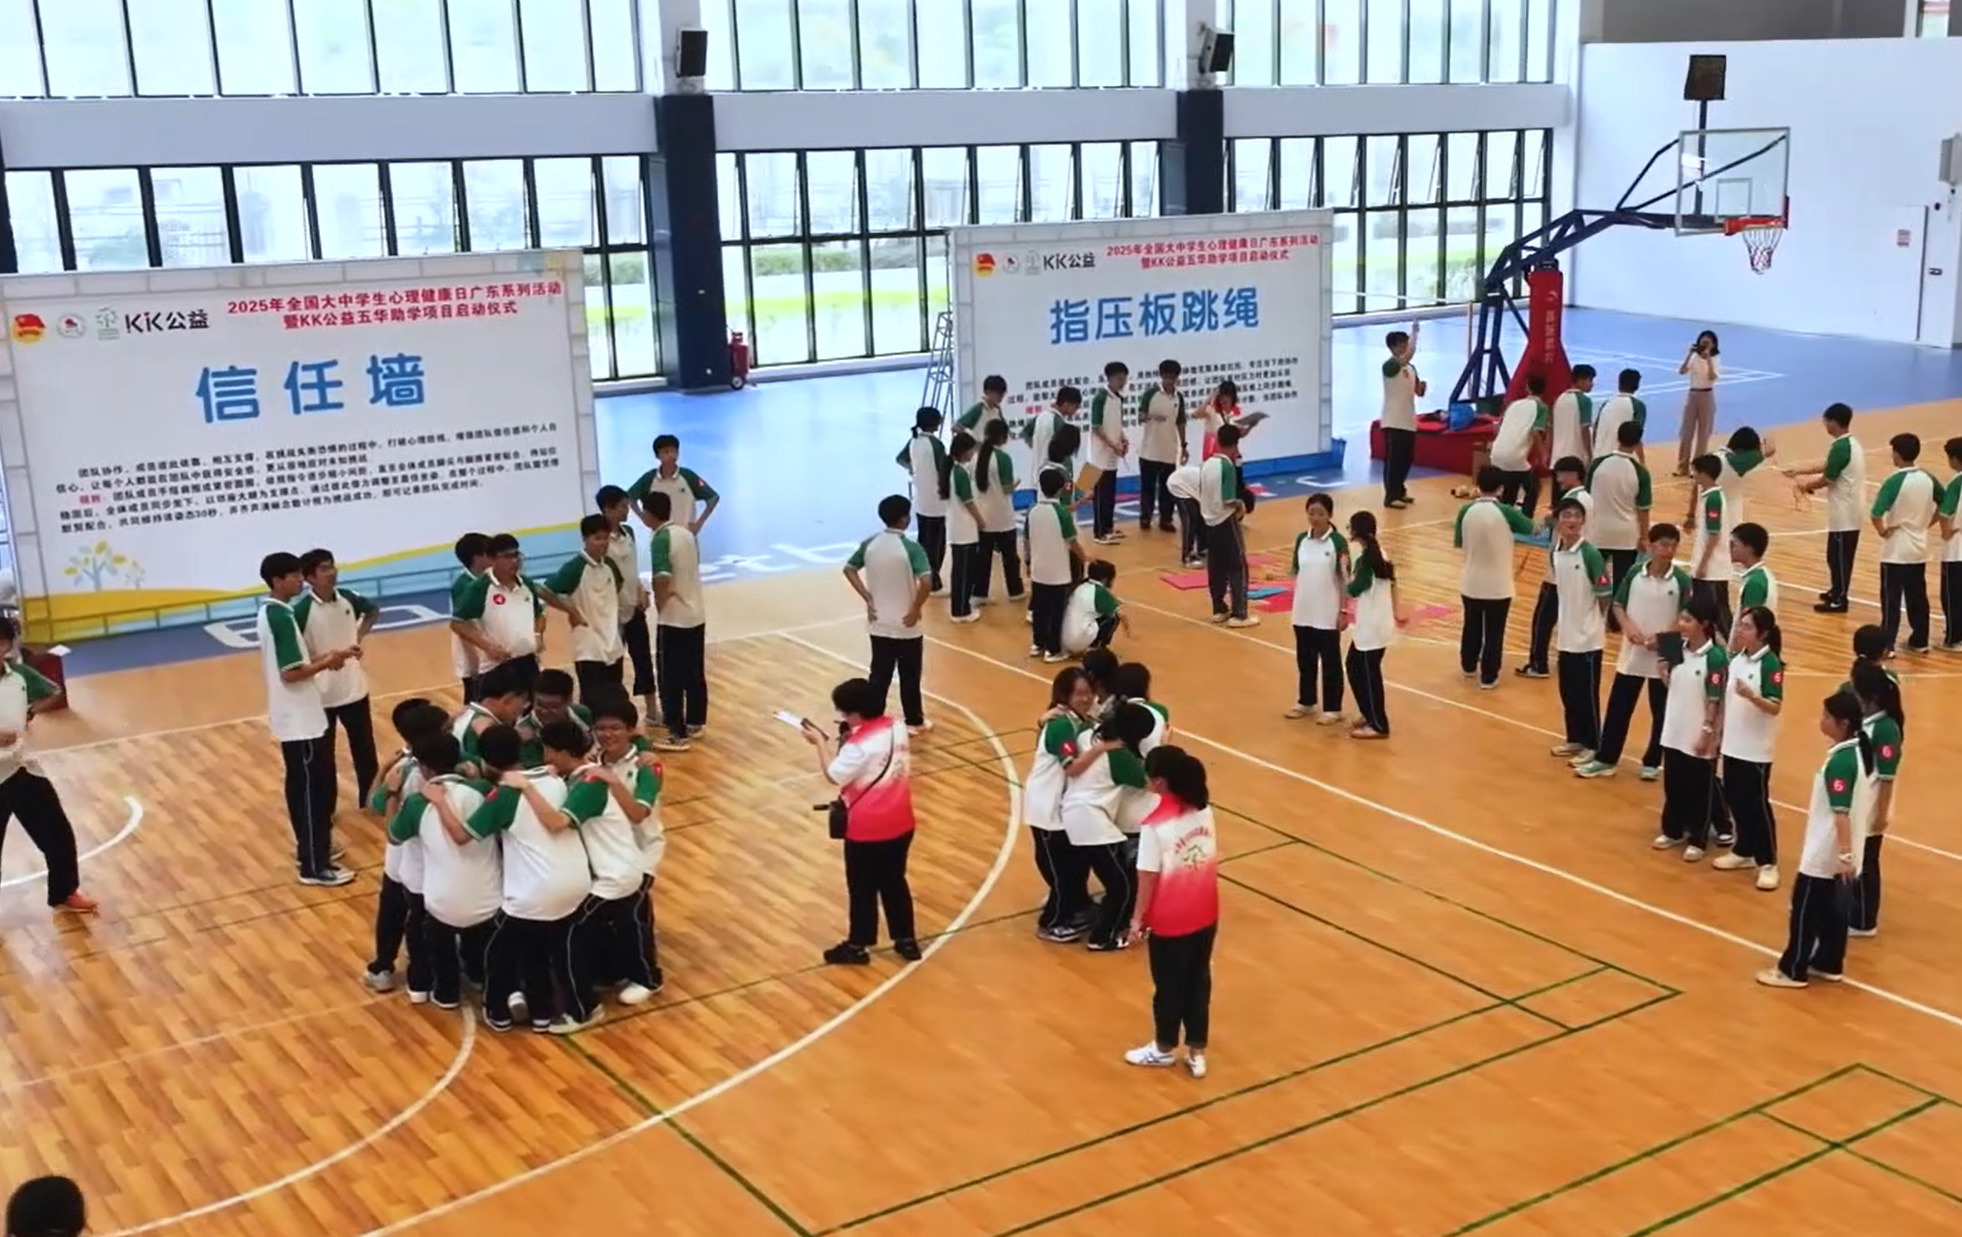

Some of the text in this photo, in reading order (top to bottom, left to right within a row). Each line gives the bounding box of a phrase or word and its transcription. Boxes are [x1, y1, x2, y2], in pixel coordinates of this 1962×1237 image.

[227, 281, 562, 314] 2025年全国大中学生心理健康日广东系列活动
[125, 308, 209, 333] KK公益
[283, 301, 518, 330] 暨KK公益五华助学项目启动仪式
[1050, 287, 1258, 345] 指压板跳绳
[195, 354, 425, 424] 信任墙
[1882, 745, 1892, 758] 6
[1833, 779, 1845, 791] 6
